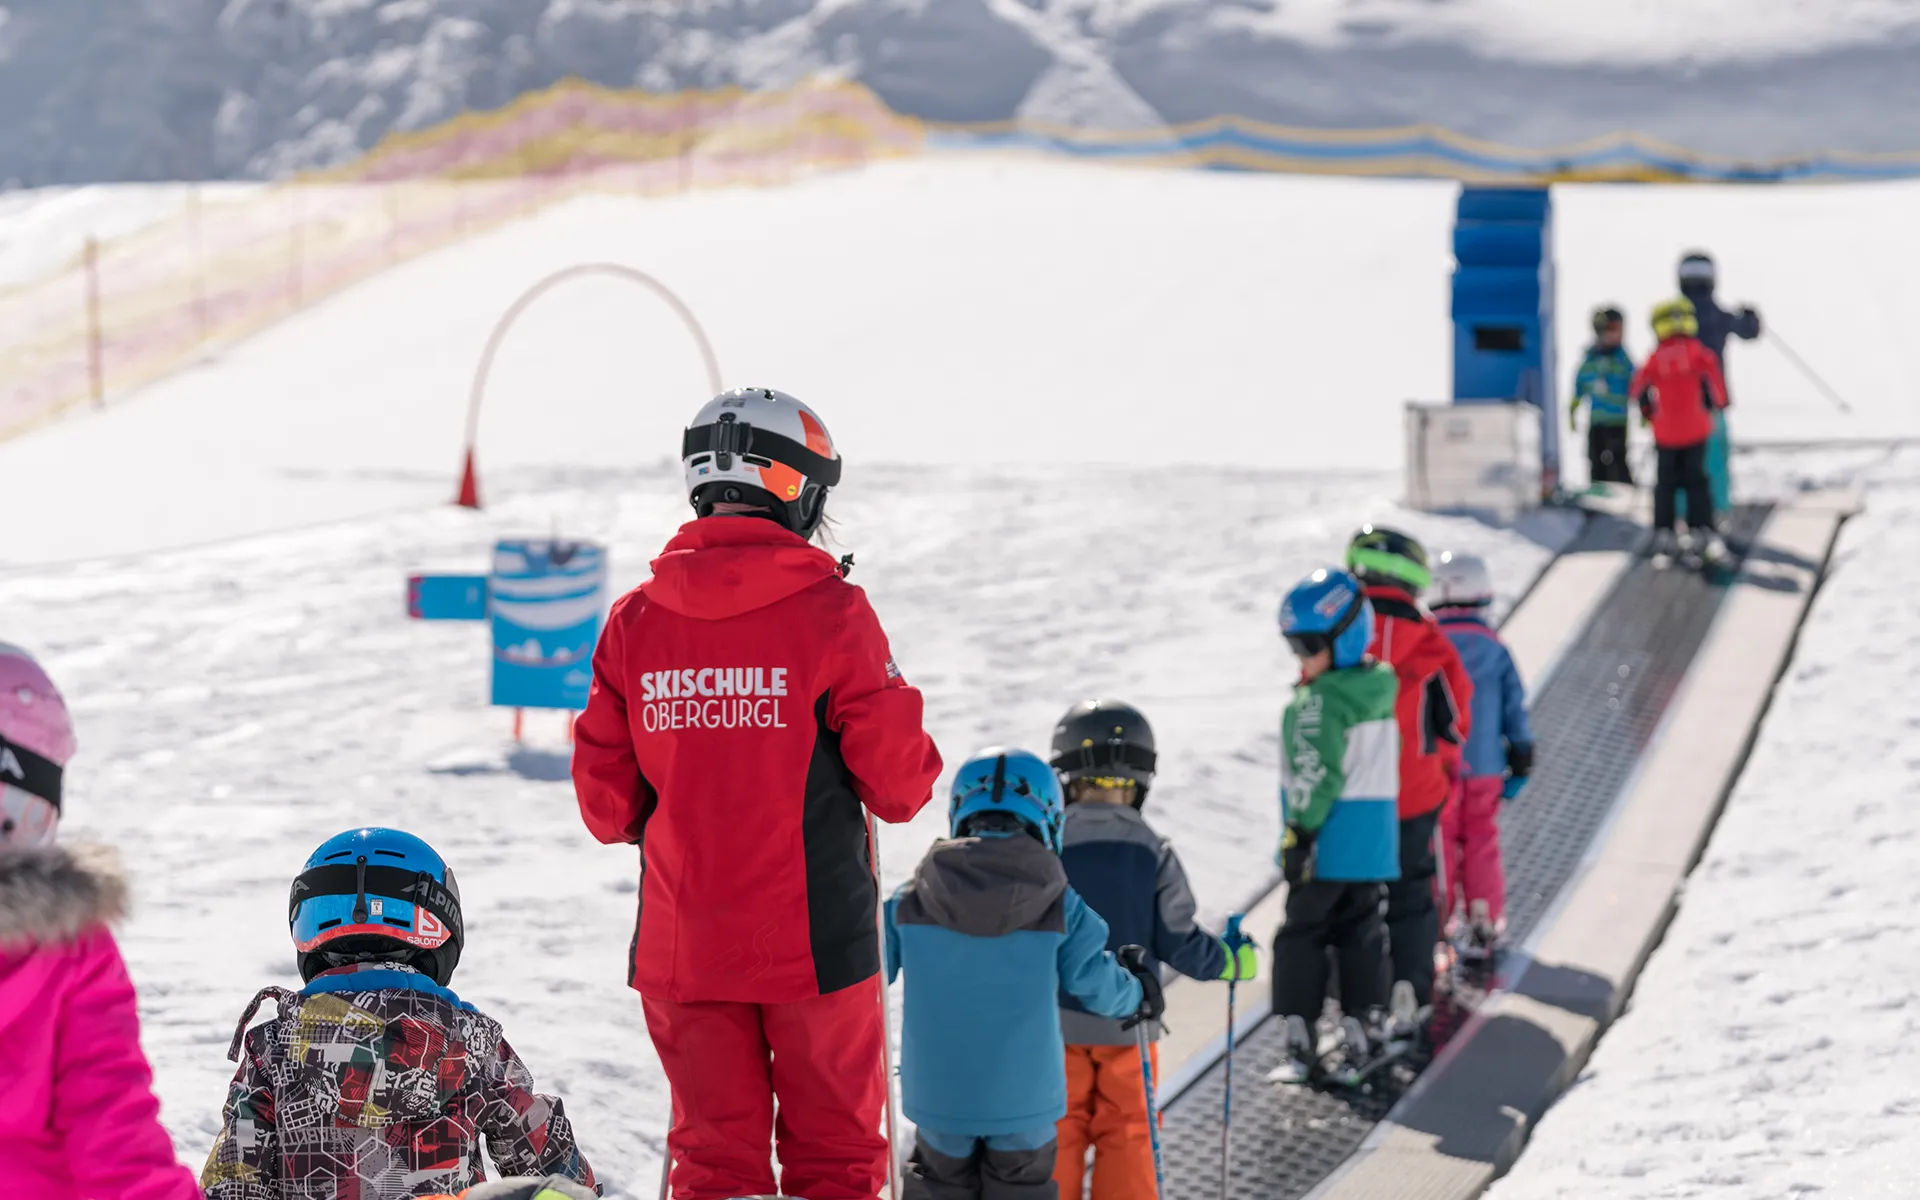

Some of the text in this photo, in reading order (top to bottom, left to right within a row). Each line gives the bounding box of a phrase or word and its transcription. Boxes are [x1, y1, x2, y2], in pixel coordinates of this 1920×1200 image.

[640, 667, 788, 701] SKISCHULE
[642, 698, 787, 732] OBERGURGL
[401, 881, 462, 937] ALPINA
